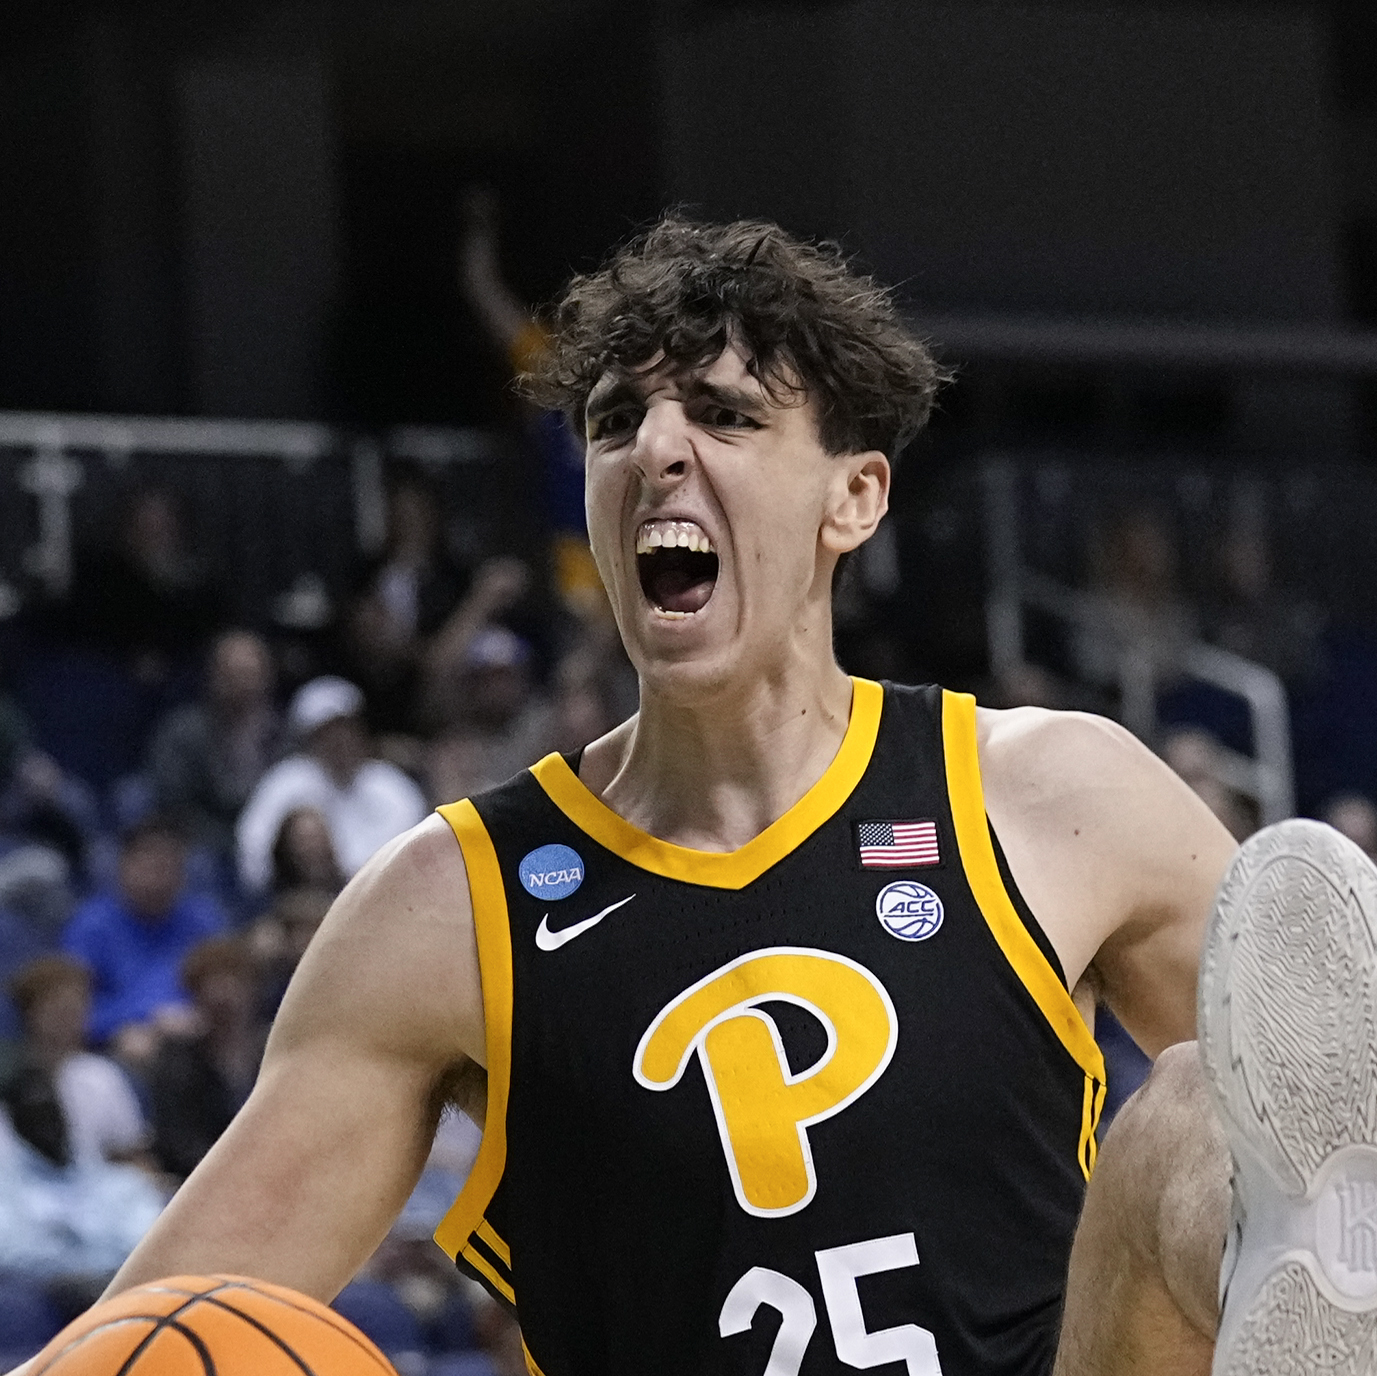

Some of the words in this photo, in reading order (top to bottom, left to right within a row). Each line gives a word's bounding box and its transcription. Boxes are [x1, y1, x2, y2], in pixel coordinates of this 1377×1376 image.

[528, 867, 582, 888] NCAA
[887, 899, 936, 914] ACC
[632, 945, 899, 1219] P
